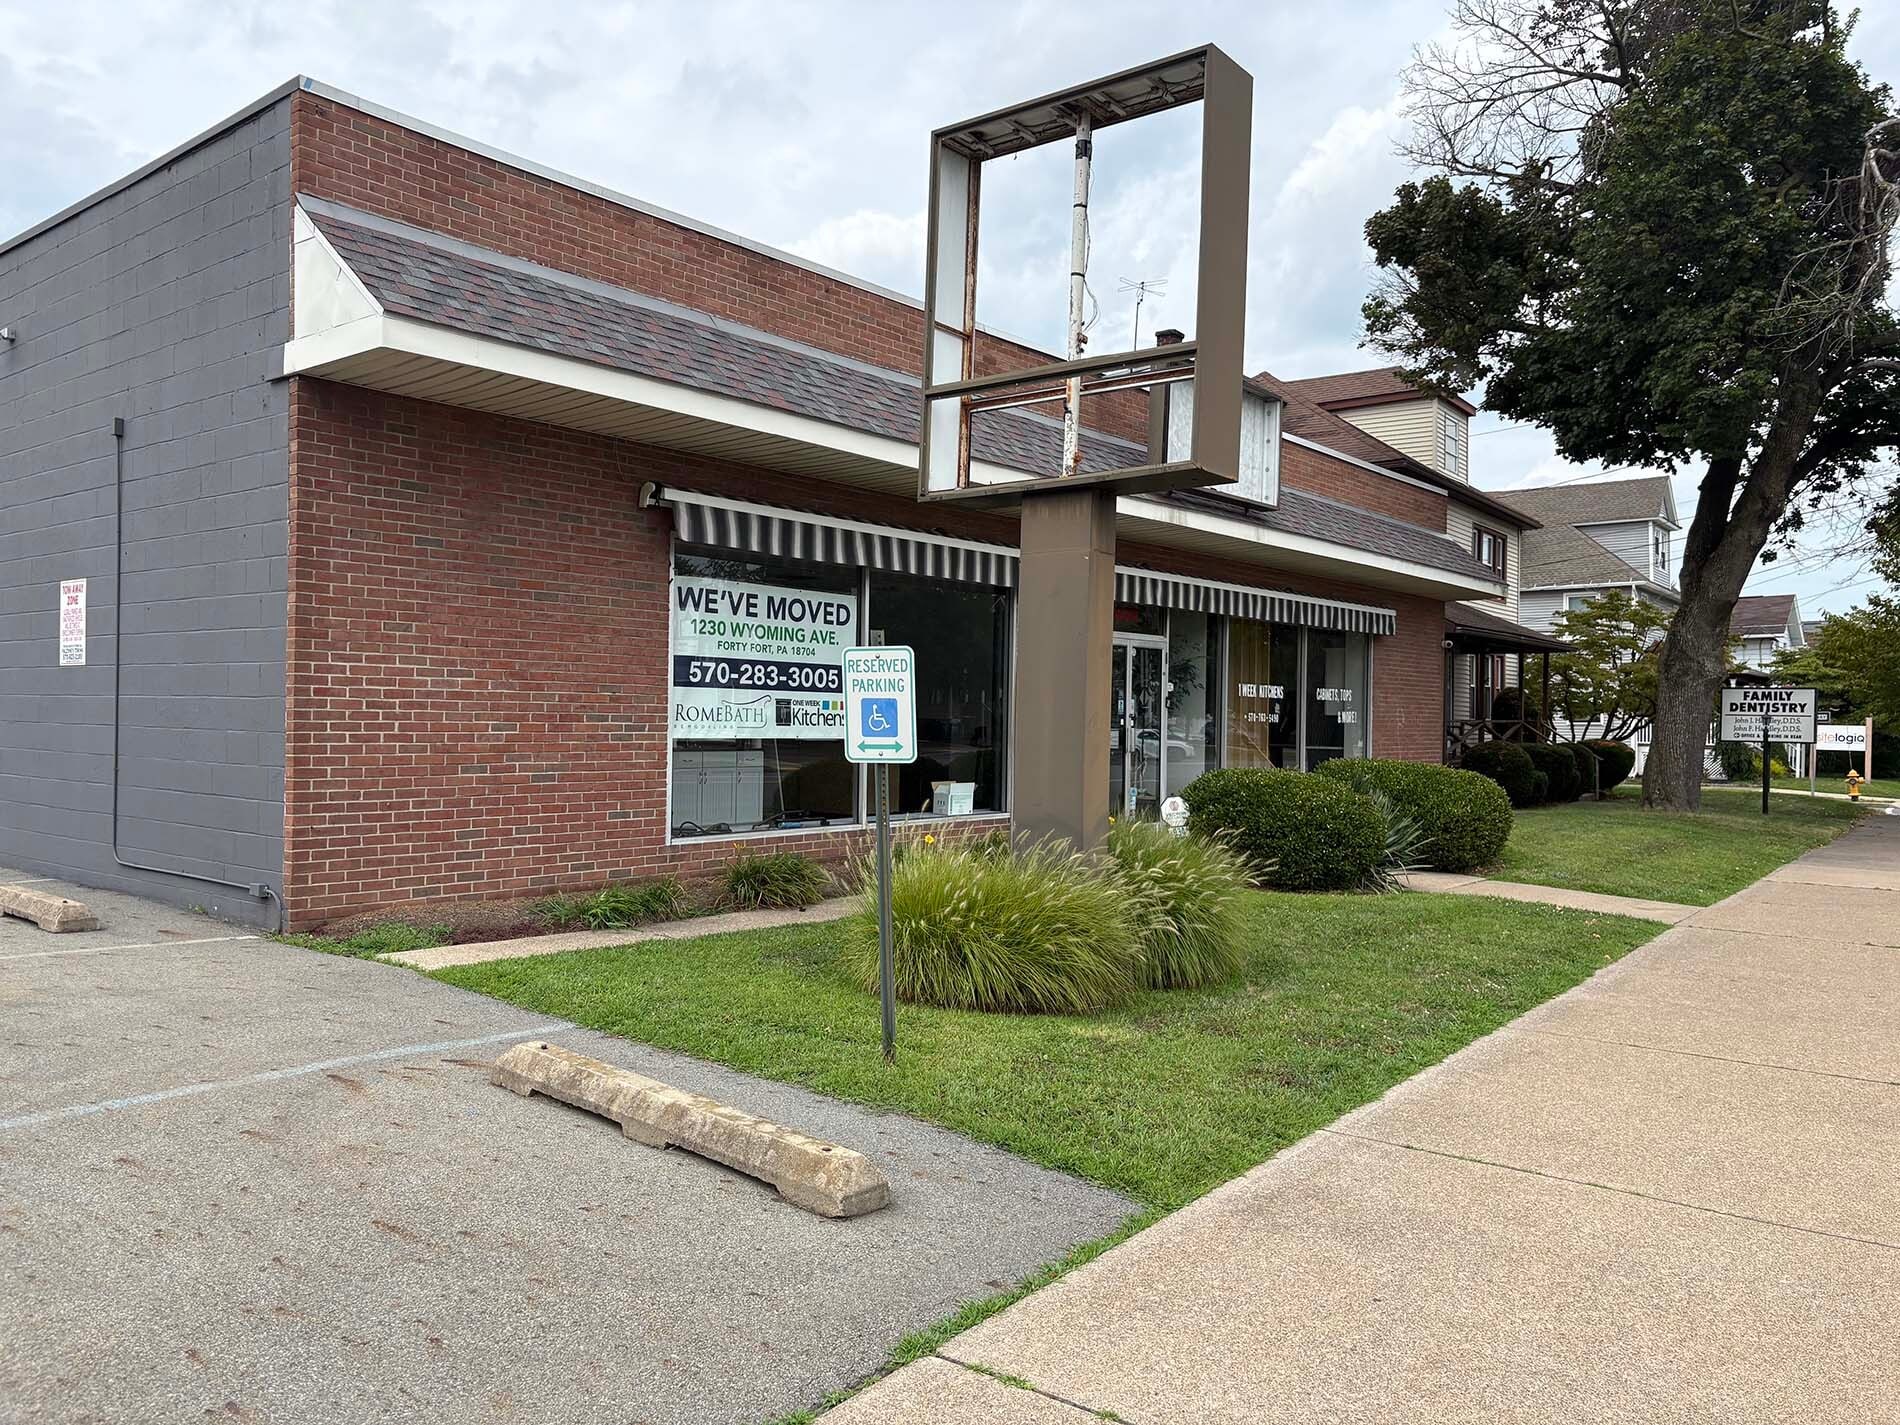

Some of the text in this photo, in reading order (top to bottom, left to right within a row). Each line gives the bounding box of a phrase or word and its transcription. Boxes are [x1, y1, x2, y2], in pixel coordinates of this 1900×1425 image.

[677, 586, 851, 627] WE'VE MOVED
[690, 618, 839, 646] 1230 WYOMING AVE.
[717, 640, 816, 657] FORTY FORT, PA 18704
[848, 658, 908, 673] RESERVED
[689, 661, 839, 689] 570-283-3005
[852, 678, 905, 693] PARKING
[1242, 684, 1257, 698] WEEK
[1259, 685, 1284, 699] KITCHENS
[1340, 688, 1352, 702] TOPS
[1743, 691, 1794, 701] FAMILY
[1729, 702, 1808, 713] DENTISTRY
[1733, 725, 1748, 733] John
